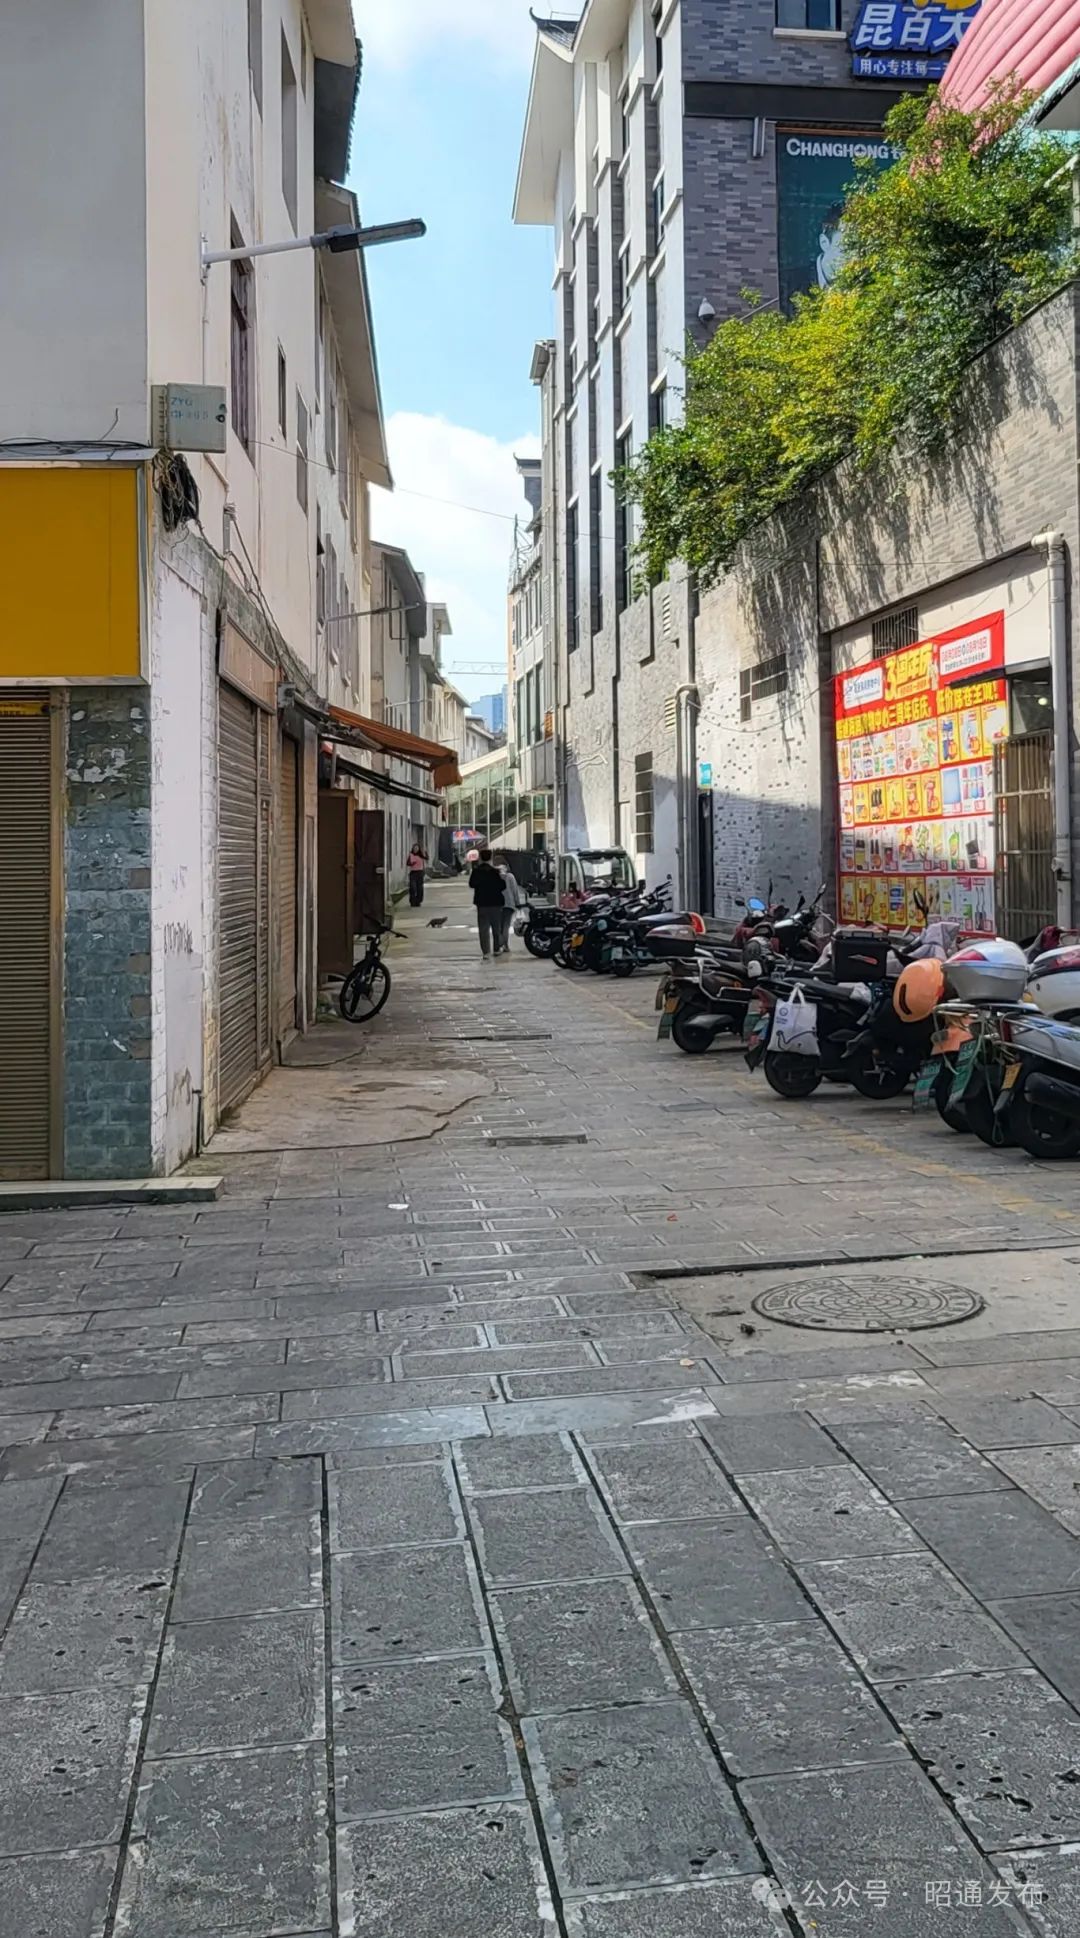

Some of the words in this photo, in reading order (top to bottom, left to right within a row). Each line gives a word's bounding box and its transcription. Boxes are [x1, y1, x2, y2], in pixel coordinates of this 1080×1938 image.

[855, 3, 973, 47] 昆百大
[859, 59, 948, 76] 用心专注每一
[786, 138, 889, 159] CHANGHONG
